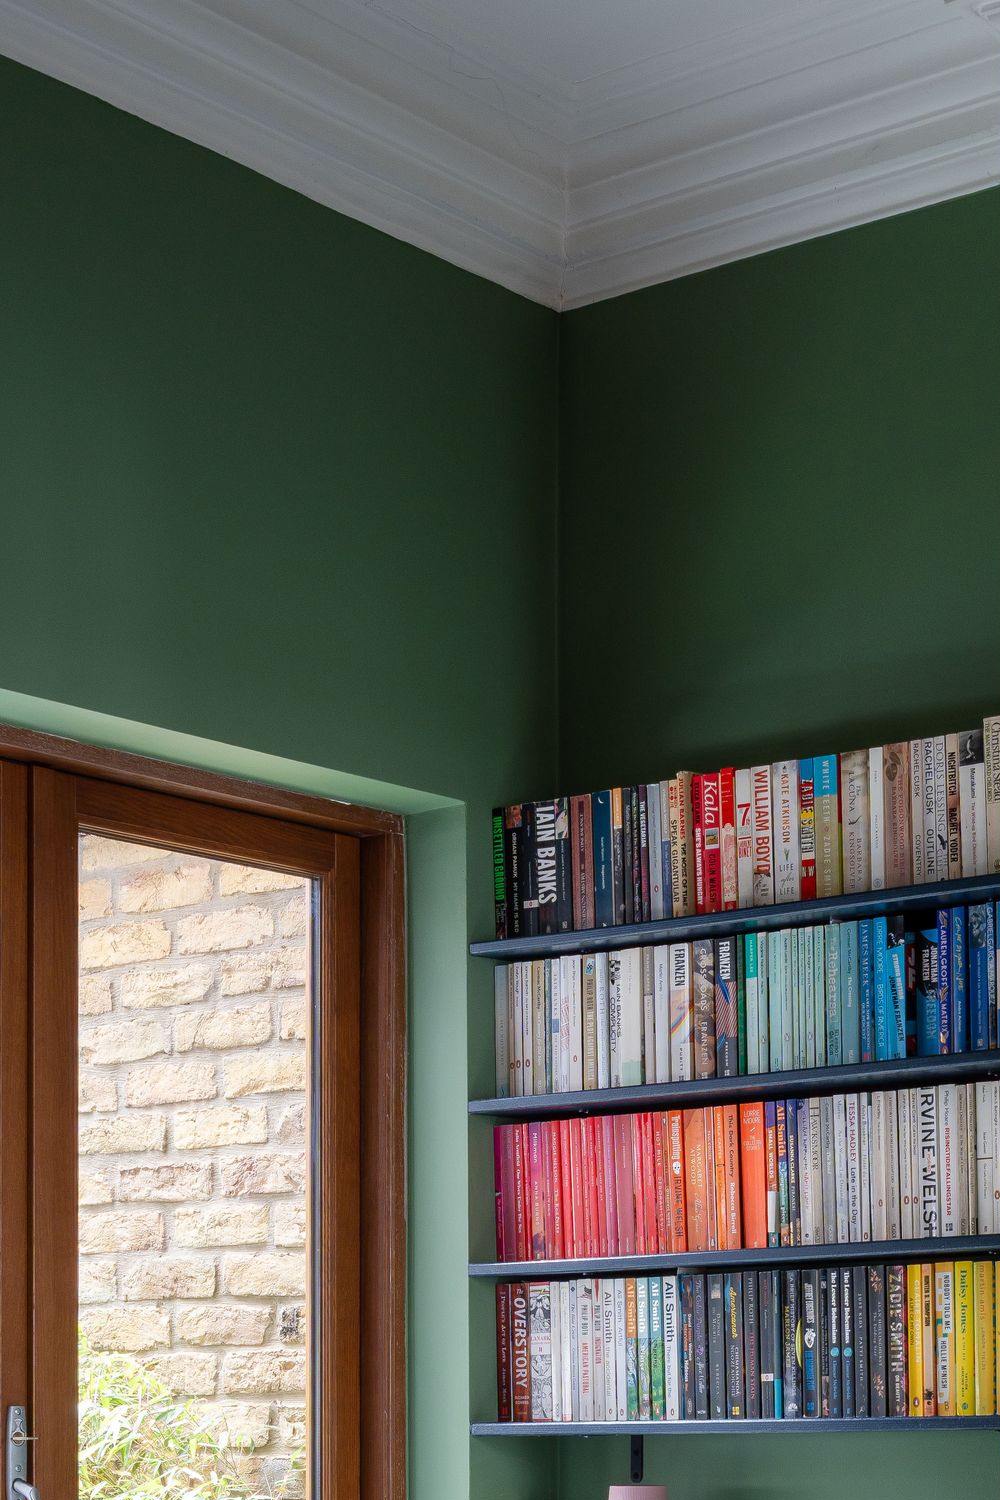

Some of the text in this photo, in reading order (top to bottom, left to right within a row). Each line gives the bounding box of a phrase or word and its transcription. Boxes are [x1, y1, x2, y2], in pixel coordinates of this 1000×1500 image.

[821, 759, 830, 790] WHITE
[848, 772, 856, 812] LACUNA
[935, 742, 946, 832] DORIS LESSING
[754, 769, 770, 831] WILLIAM
[781, 774, 791, 843] KATE ATKINSON
[801, 777, 815, 853] ZADIE SMITH
[822, 794, 830, 822] TEETH
[924, 741, 935, 875] RACHEL CUSK OUTLINE
[948, 752, 958, 863] NIGHTBITCH RACHEL YODER
[492, 816, 505, 900] UNSETTLED GROUND
[535, 806, 557, 904] IAIN BANKS
[703, 781, 718, 903] Kala COLIN WALSH
[756, 836, 771, 873] BOYD
[823, 836, 831, 864] ZADIE
[682, 879, 688, 888] OF
[779, 864, 794, 872] LIFE
[779, 887, 794, 896] LIFE
[674, 948, 686, 987] FRANZEN
[718, 941, 731, 980] FRANZEN
[922, 949, 930, 981] FRANZEN
[930, 945, 938, 983] JONATHAN
[940, 958, 948, 988] GROFF
[878, 1005, 884, 1015] OF
[888, 975, 904, 1042] JONATHAN FRANZEN
[809, 1106, 820, 1171] HAWKSMOOR
[920, 1086, 935, 1158] IRVINE
[671, 1115, 684, 1237] Trainspotting IRVINE WELSH
[604, 1292, 612, 1307] Ali
[665, 1282, 674, 1299] Ali
[889, 1274, 901, 1317] ZADIE
[959, 1270, 968, 1300] Daisy
[604, 1310, 613, 1343] Smith
[638, 1301, 646, 1333] Smith
[666, 1304, 675, 1342] Smith
[729, 1287, 738, 1340] Americanah
[945, 1320, 951, 1330] ME
[514, 1297, 527, 1388] OVERSTORY
[890, 1322, 903, 1372] SMITH
